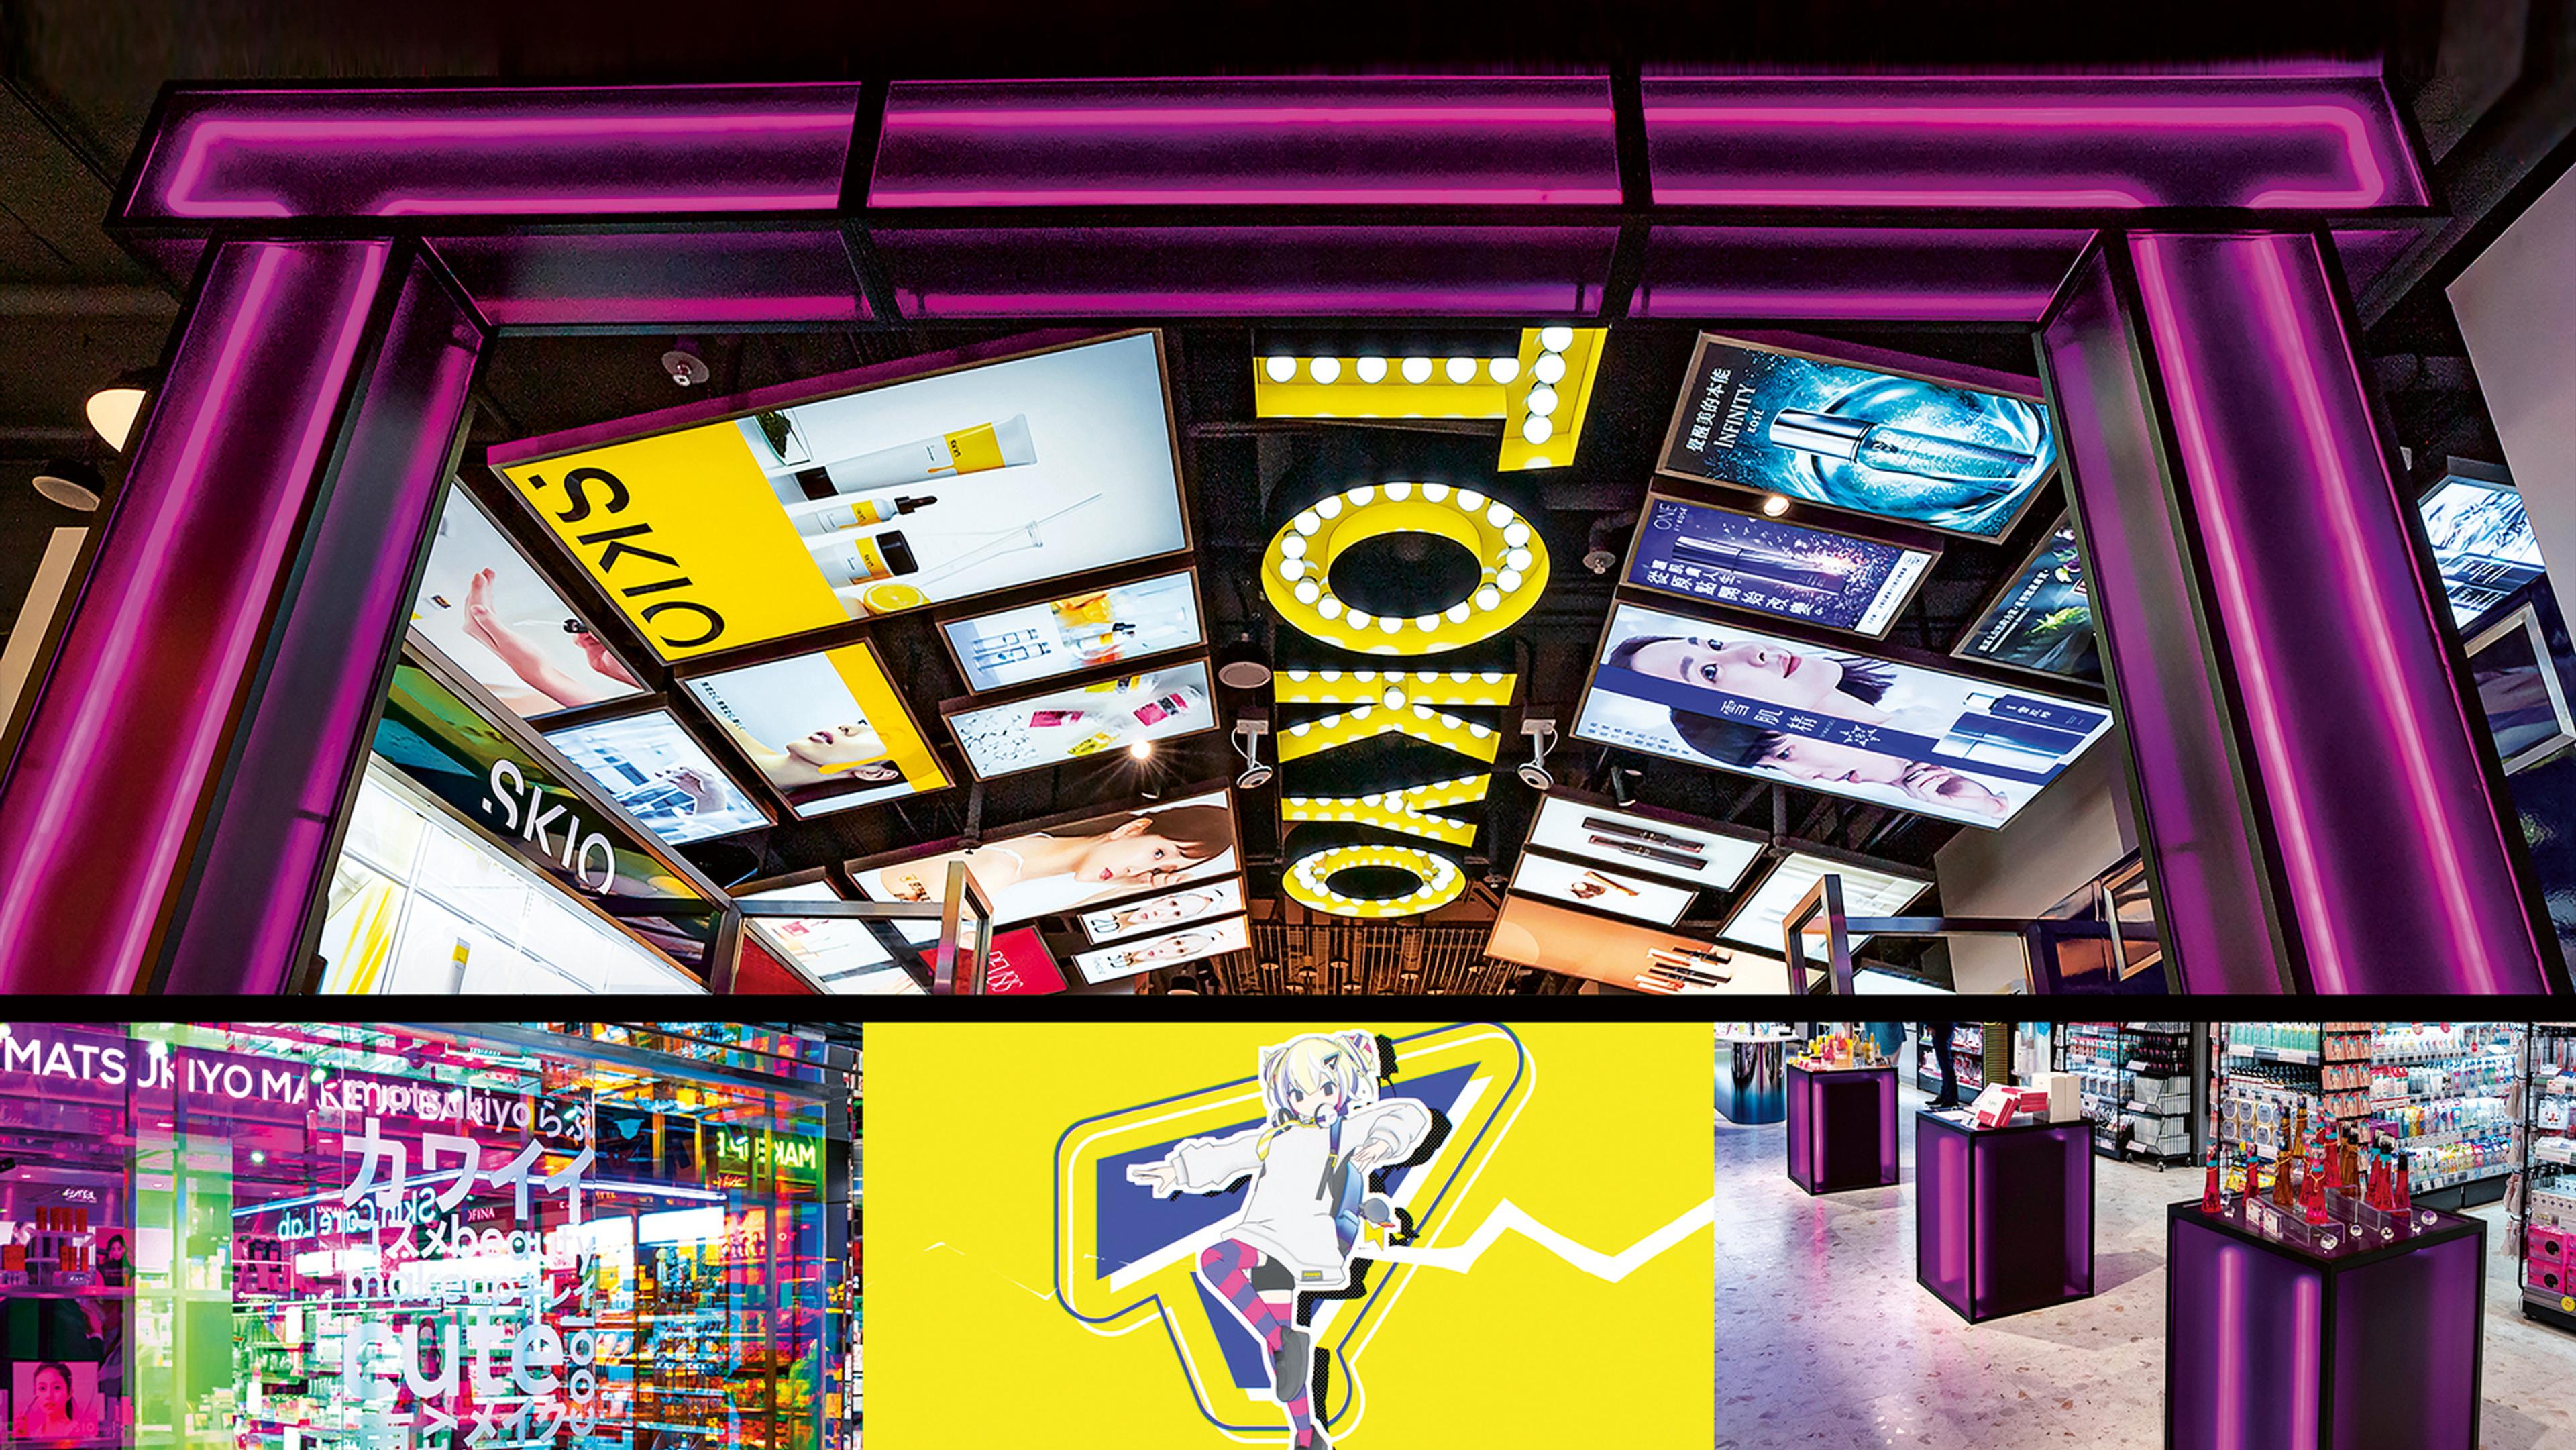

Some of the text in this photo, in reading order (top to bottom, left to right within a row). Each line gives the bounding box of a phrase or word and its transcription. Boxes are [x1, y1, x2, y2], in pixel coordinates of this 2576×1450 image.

[1713, 383, 1756, 448] INFINITY
[1654, 503, 1677, 530] ONE
[1252, 327, 1608, 918] TOKYO
[1721, 699, 1817, 732] 雪肌精
[344, 1308, 563, 1398] cute
